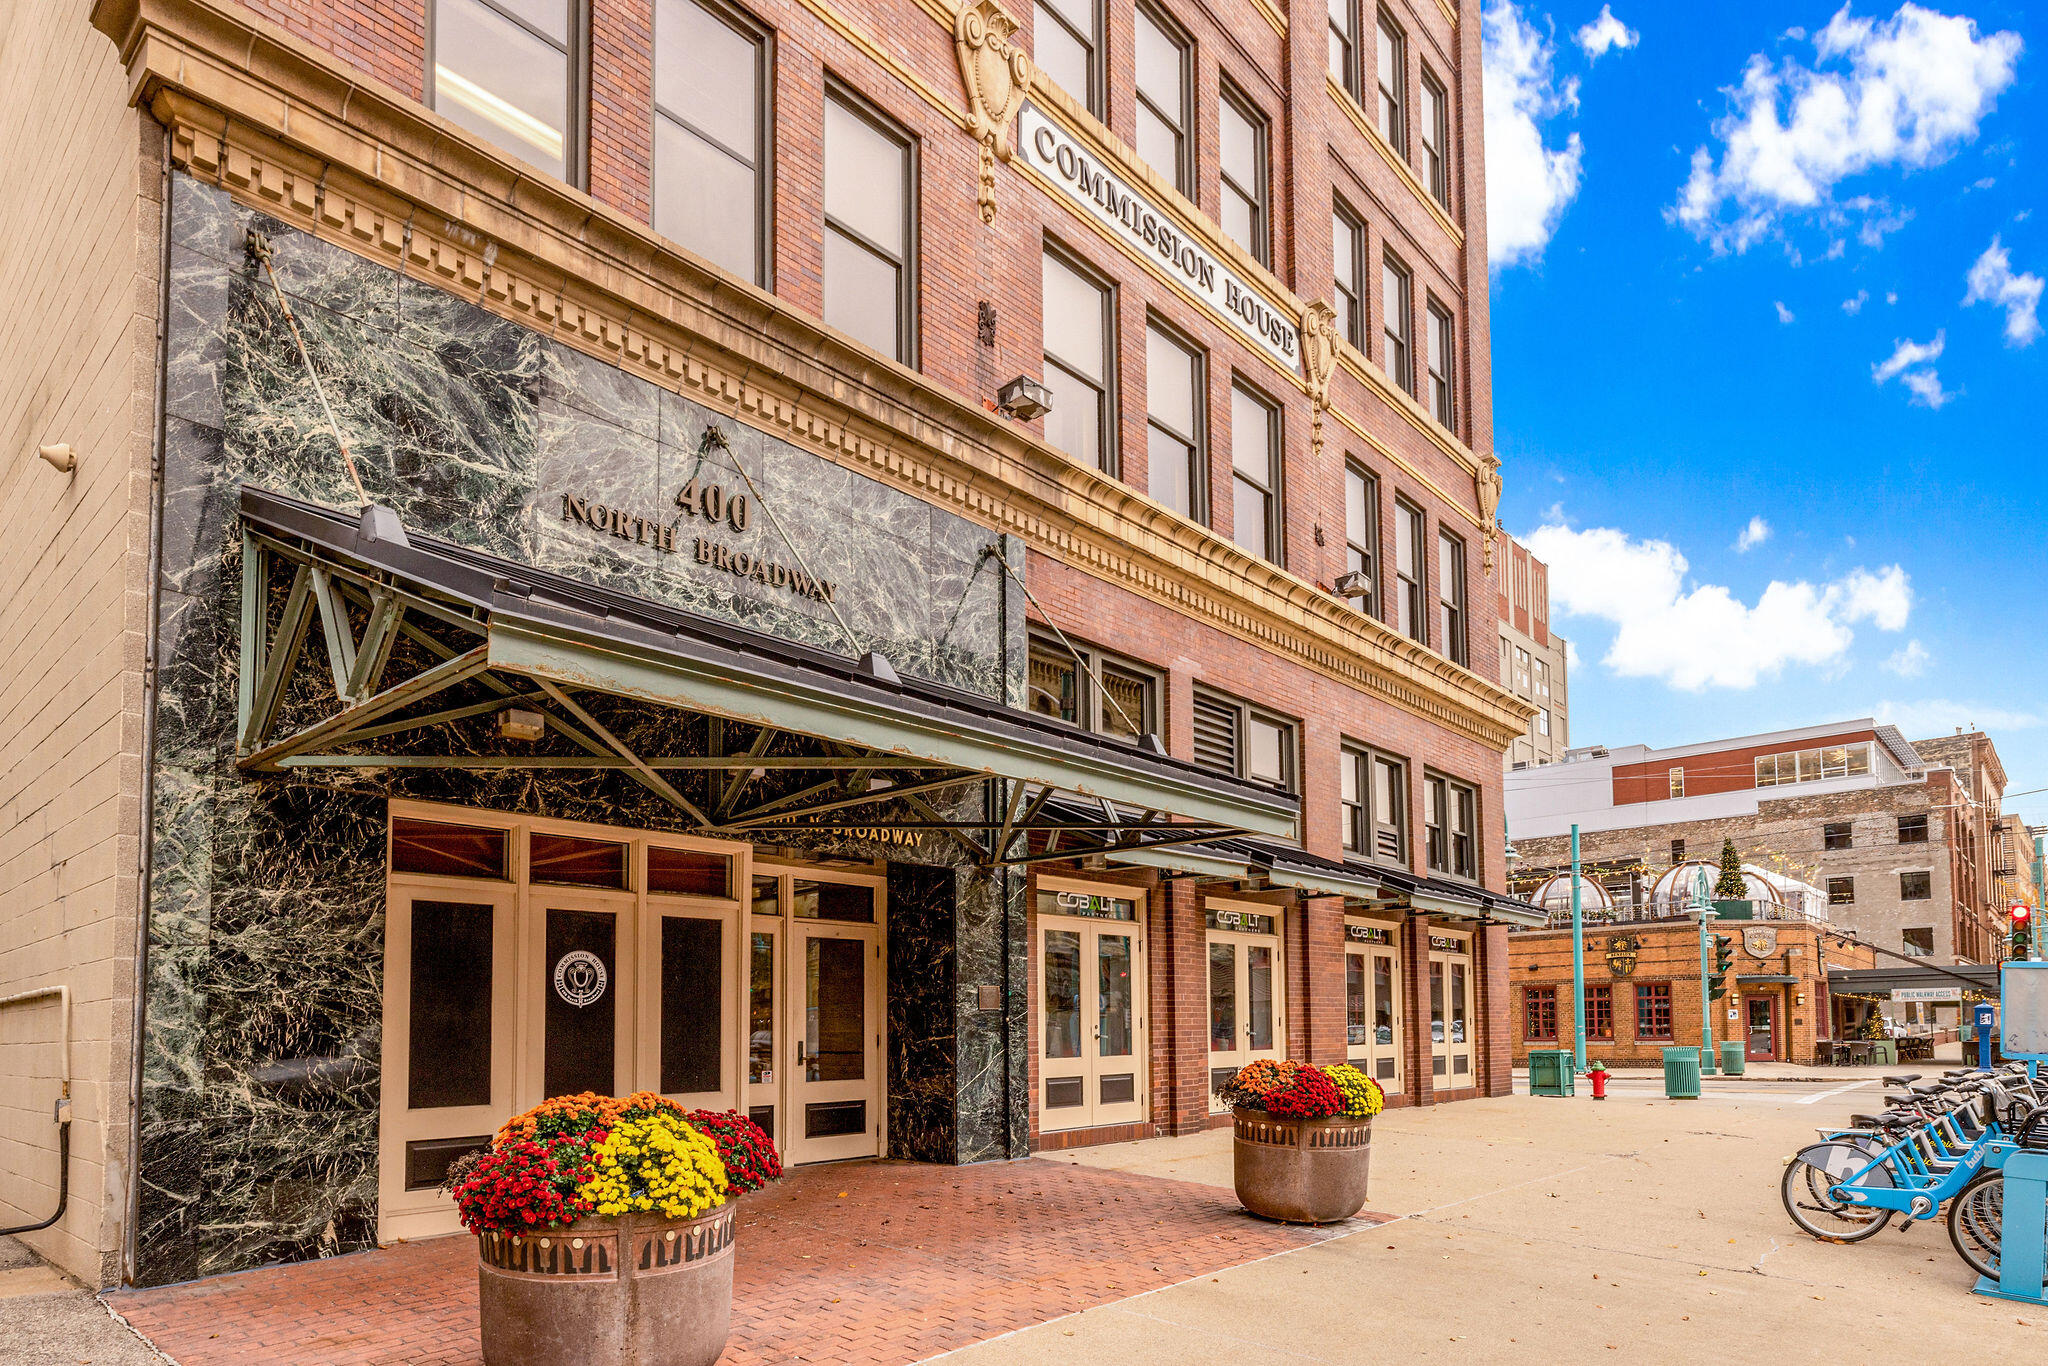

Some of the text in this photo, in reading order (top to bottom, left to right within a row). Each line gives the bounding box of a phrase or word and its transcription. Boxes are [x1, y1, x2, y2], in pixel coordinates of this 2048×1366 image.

[1035, 126, 1294, 358] COMMISSION HOUSE
[675, 477, 752, 533] 400
[560, 492, 838, 604] NORTH BROADWAY
[1057, 892, 1116, 911] COBALT
[1082, 911, 1116, 919] PARTNERS
[1217, 911, 1260, 927] COBALT
[1351, 926, 1383, 940] COBALT
[1431, 936, 1458, 949] COBALT
[1965, 1142, 1986, 1170] bubl
